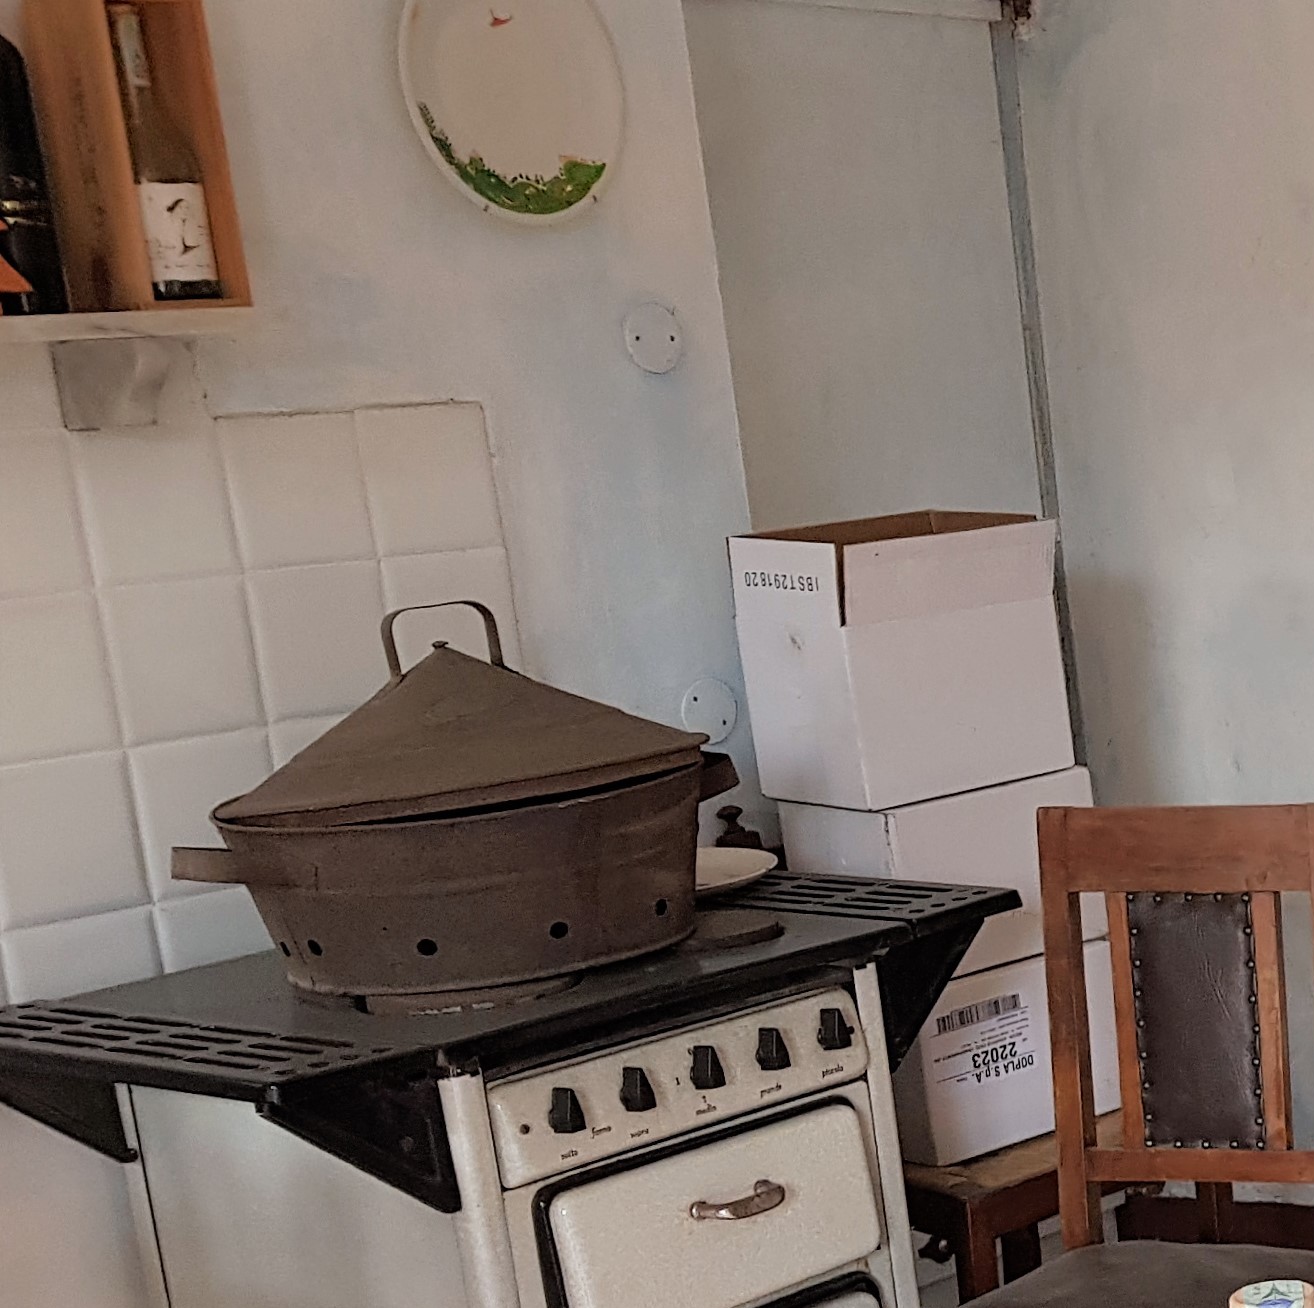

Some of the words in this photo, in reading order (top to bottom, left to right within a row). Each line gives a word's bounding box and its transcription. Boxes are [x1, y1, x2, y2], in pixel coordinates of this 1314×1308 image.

[744, 571, 819, 592] IBST291820
[972, 1041, 1018, 1069] 22023
[1003, 1054, 1034, 1074] DOPLA
